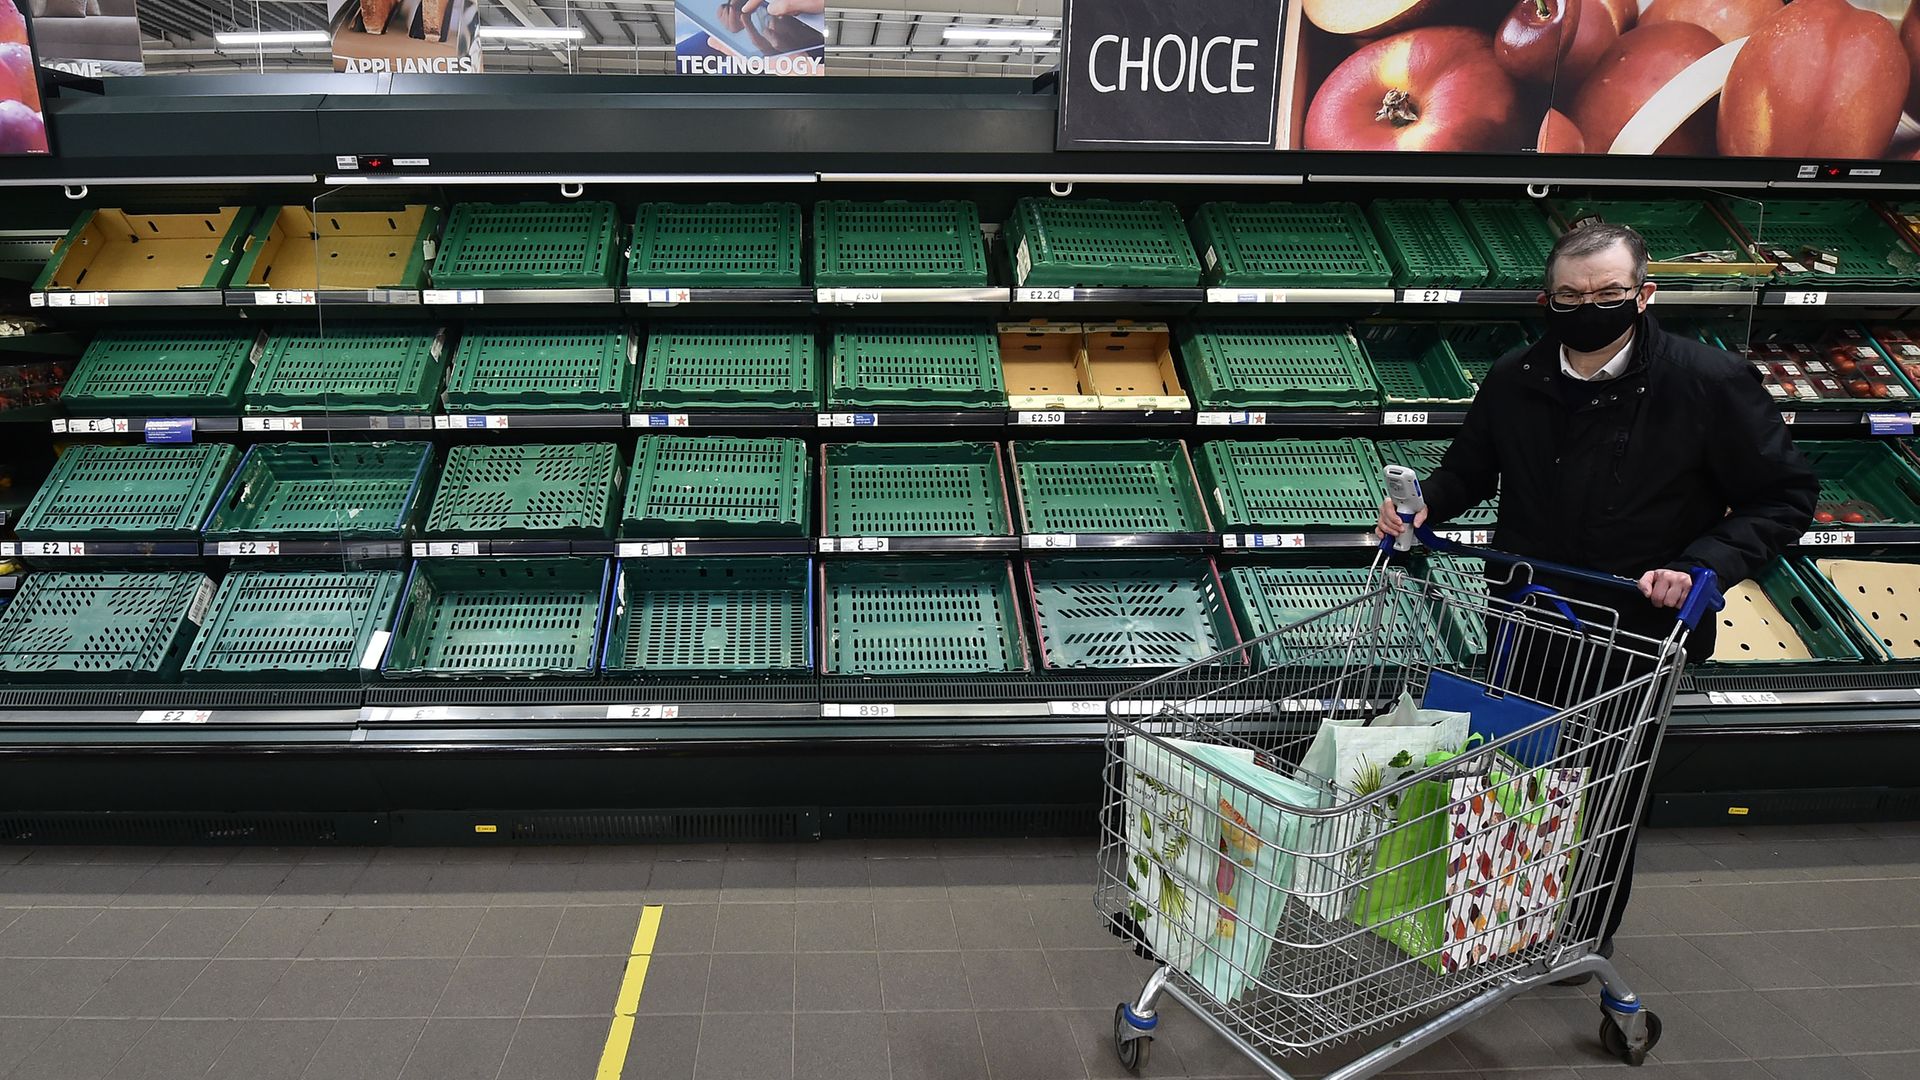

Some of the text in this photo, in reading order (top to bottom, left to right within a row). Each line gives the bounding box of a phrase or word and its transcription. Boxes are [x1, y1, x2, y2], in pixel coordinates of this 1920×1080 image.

[345, 56, 471, 73] APPLIANCES
[678, 56, 821, 74] TECHNOLOGY
[1089, 34, 1258, 93] CHOICE
[41, 62, 102, 77] OME
[1030, 290, 1060, 299] £2.20
[1423, 290, 1440, 301] £2
[1803, 292, 1817, 303] £3
[1031, 413, 1061, 422] £2.50
[1396, 413, 1426, 422] £1.69
[43, 543, 59, 554] £2
[239, 542, 256, 554] £2
[162, 711, 184, 721] £2
[631, 707, 651, 717] £2
